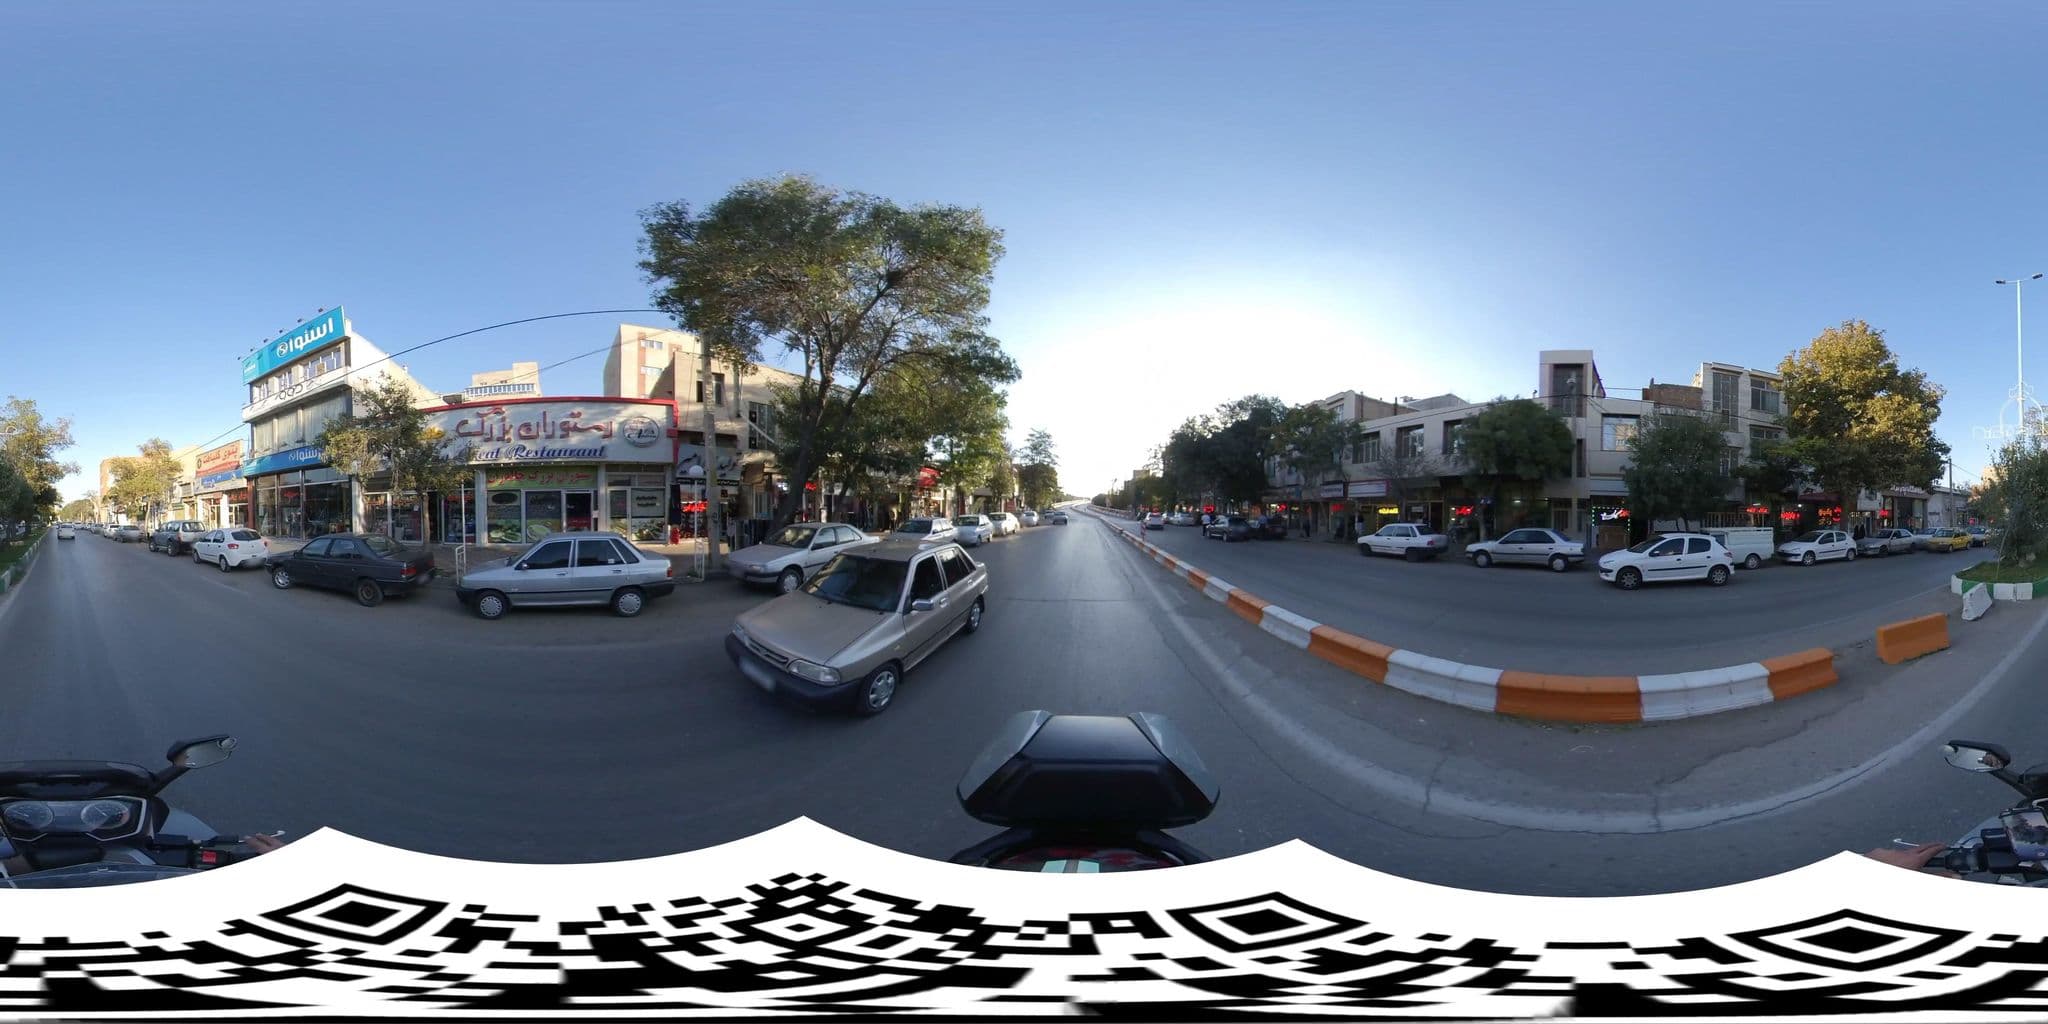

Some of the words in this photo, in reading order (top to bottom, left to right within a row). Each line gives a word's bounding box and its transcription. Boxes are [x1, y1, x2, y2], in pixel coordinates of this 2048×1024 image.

[288, 318, 334, 352] اسنوا
[455, 406, 513, 443] بزرگ
[518, 410, 614, 441] رستوران
[507, 444, 607, 460] Restaurant
